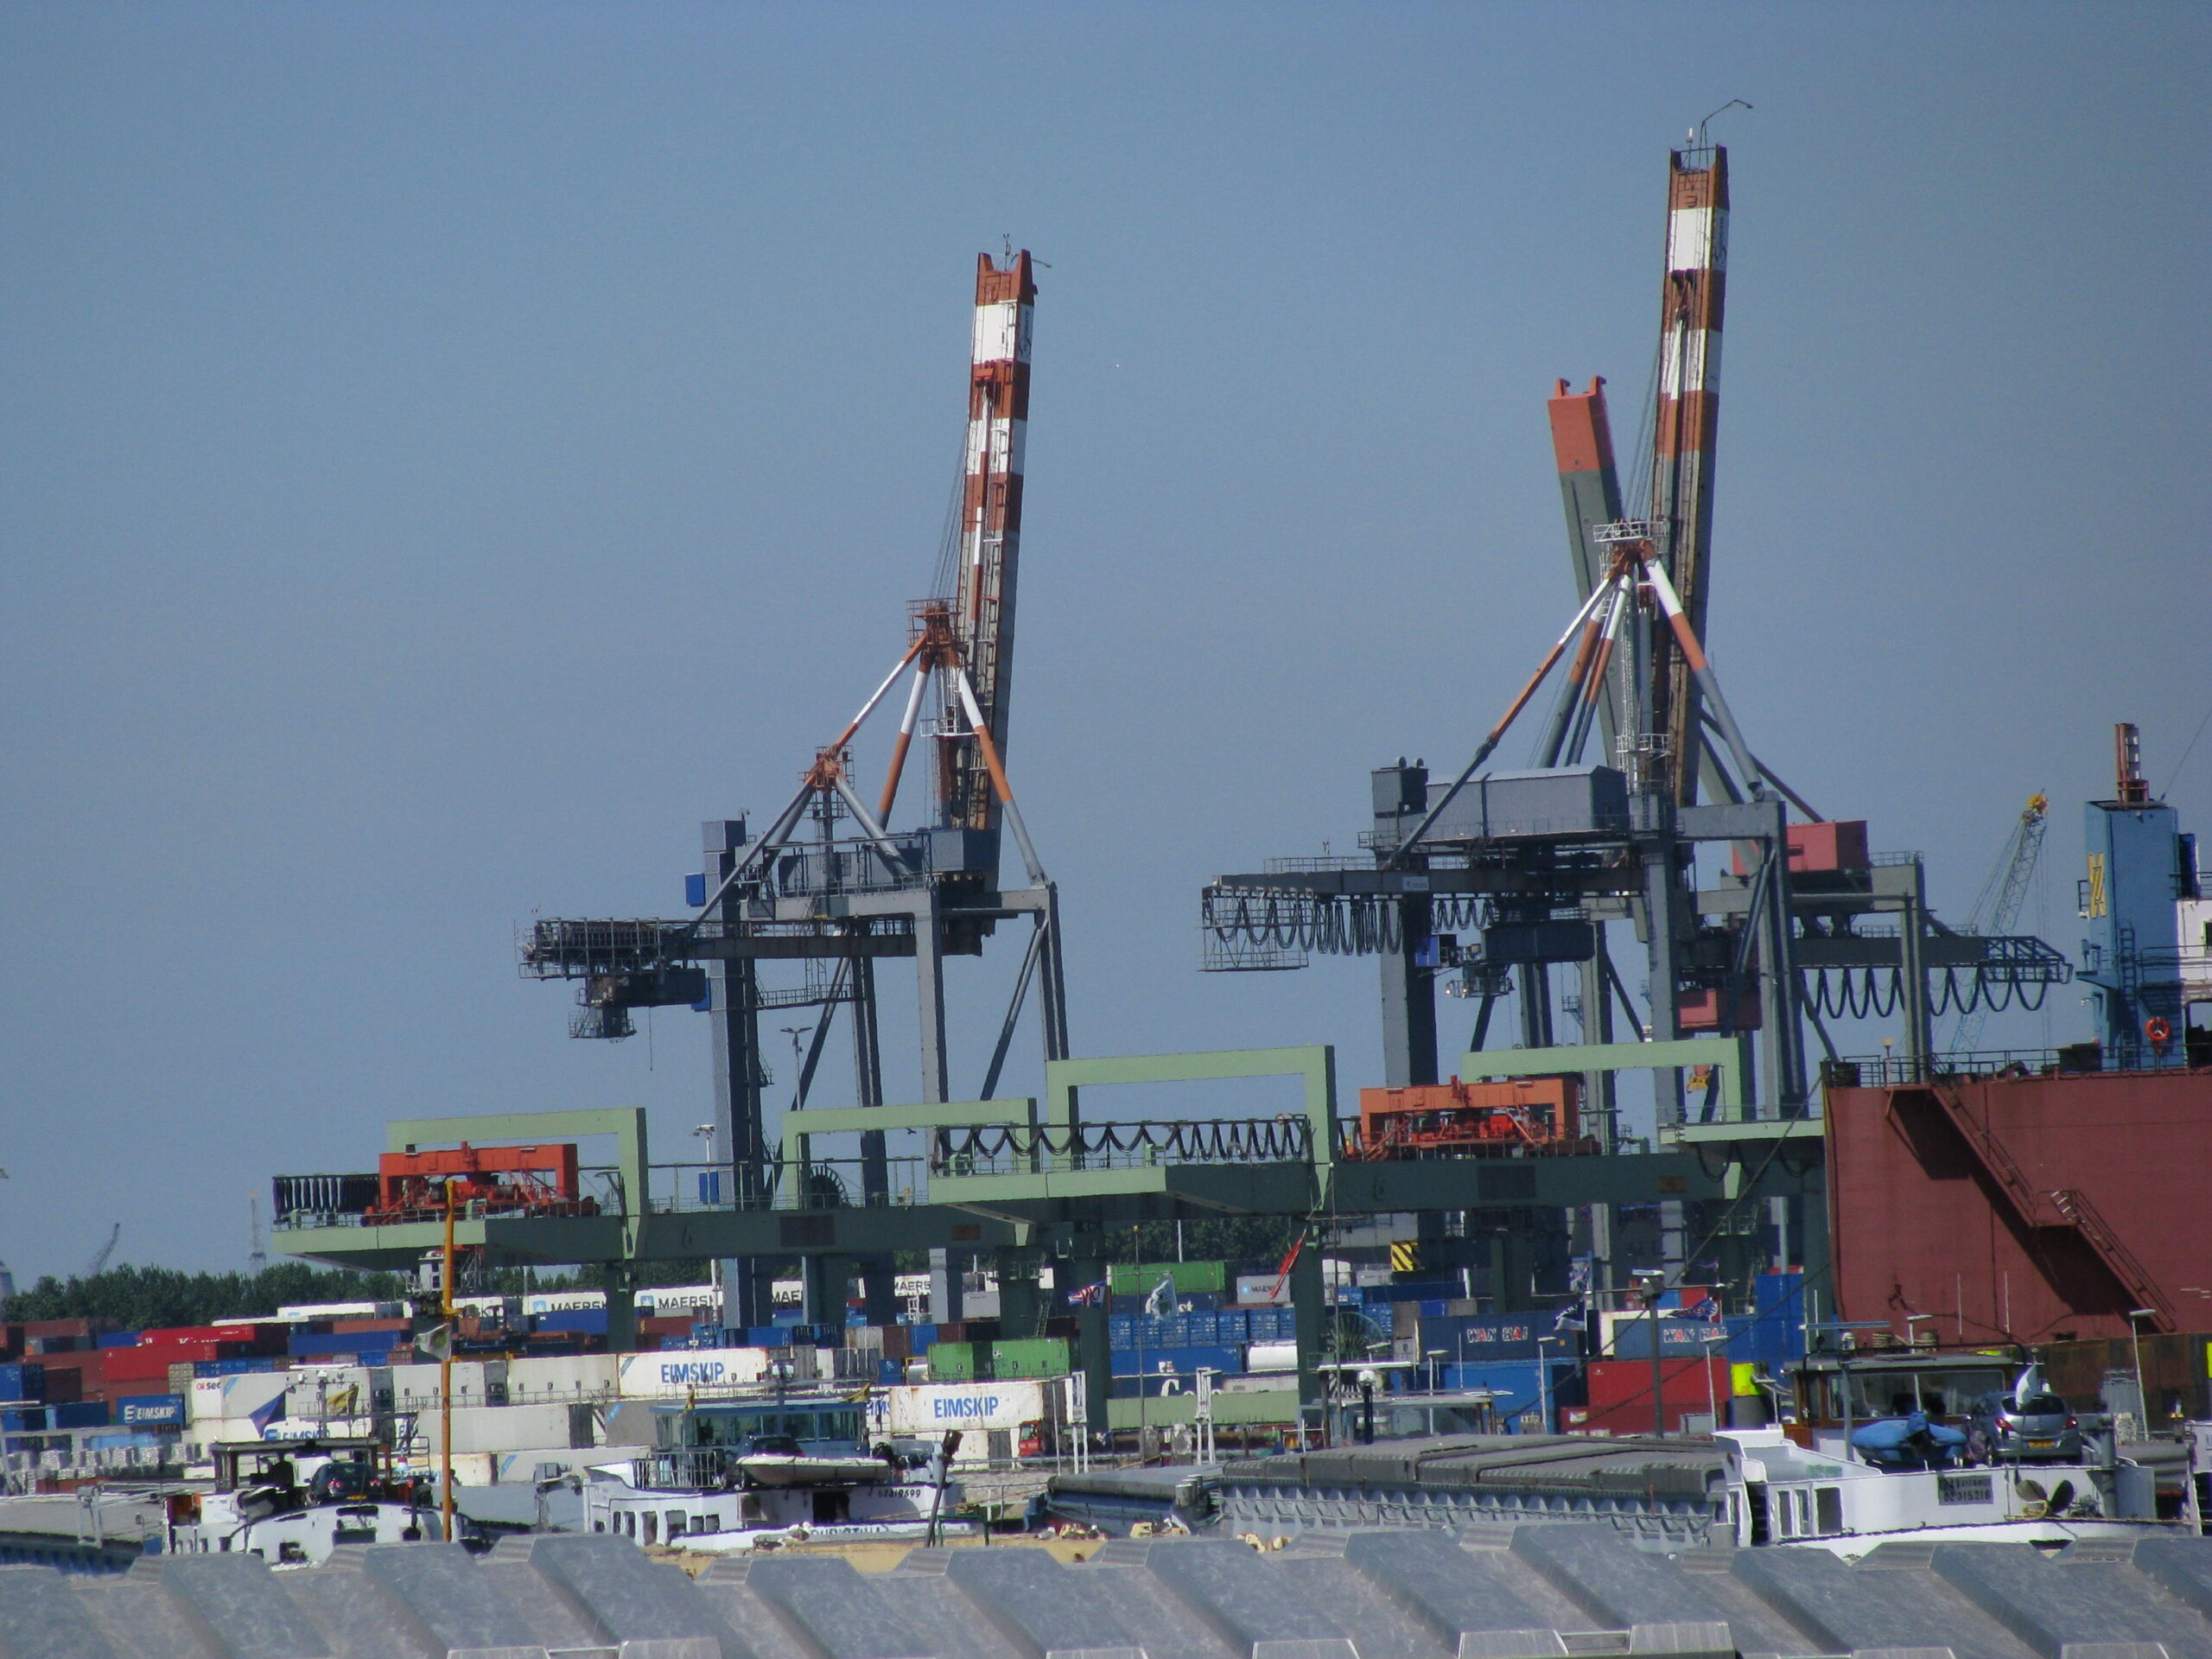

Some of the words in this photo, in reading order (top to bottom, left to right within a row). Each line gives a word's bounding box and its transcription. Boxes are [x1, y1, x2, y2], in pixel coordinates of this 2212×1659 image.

[772, 1290, 802, 1302] MAE
[661, 1362, 724, 1383] EIMSKIP
[137, 1406, 175, 1420] EIMSKIP
[933, 1396, 999, 1418] EIMSKIP
